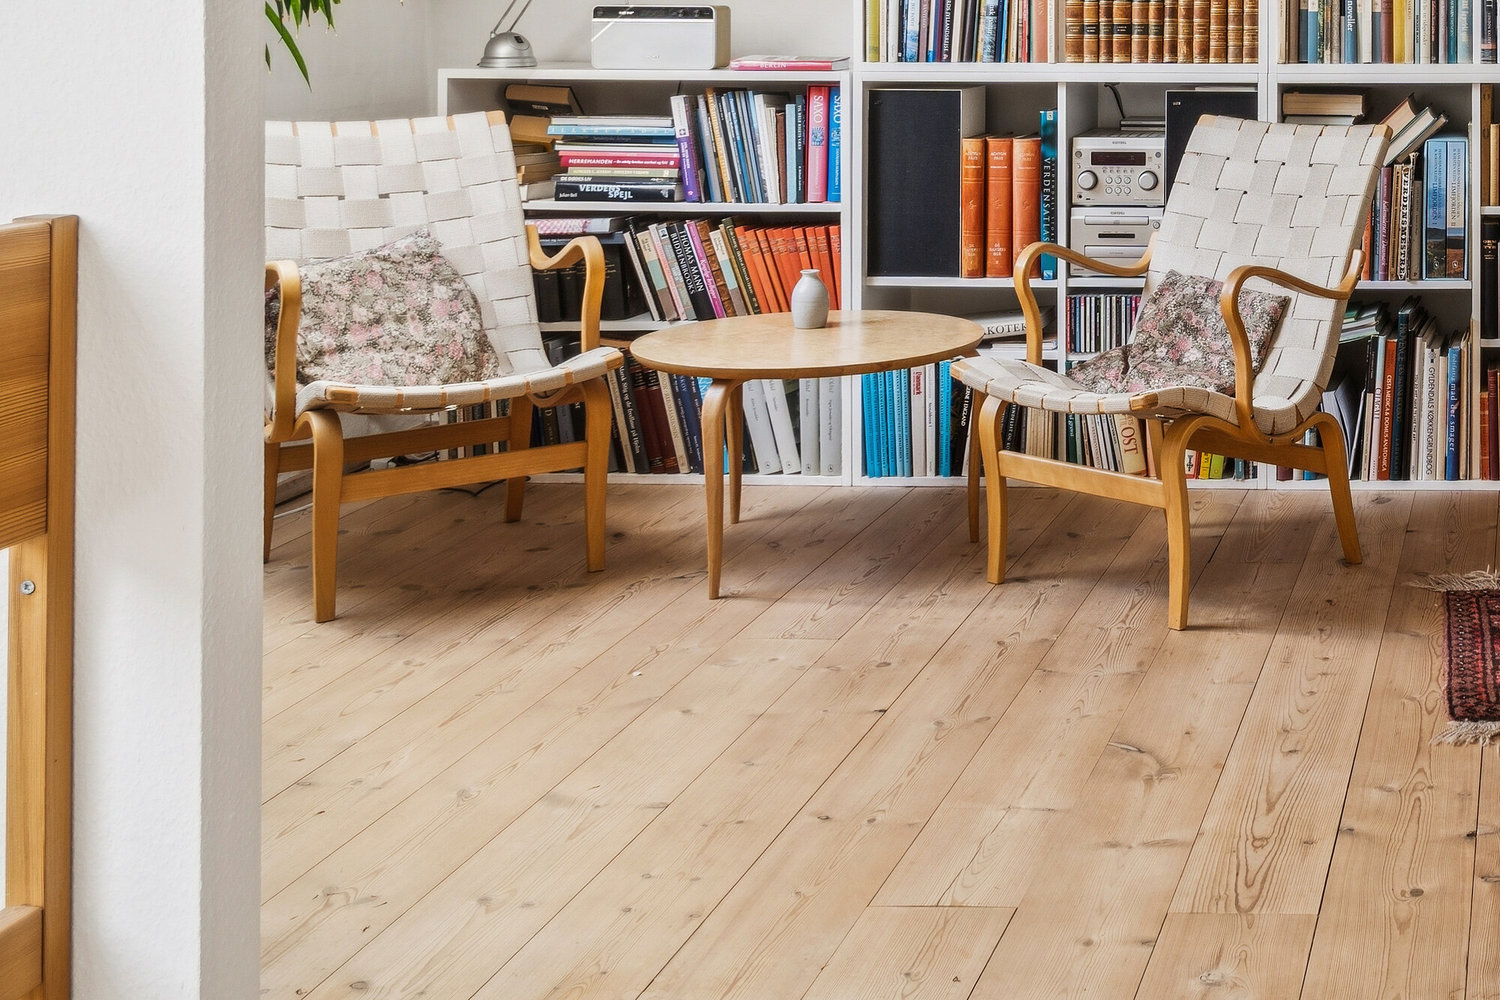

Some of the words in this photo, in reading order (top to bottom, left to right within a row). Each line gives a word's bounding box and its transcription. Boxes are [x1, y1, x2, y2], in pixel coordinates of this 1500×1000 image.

[1347, 0, 1355, 31] noveller
[813, 95, 823, 123] SAXO
[579, 184, 621, 192] VERDENS
[608, 191, 633, 199] SPEJL
[1043, 157, 1051, 241] VERDENSATLAS
[670, 232, 695, 295] BUDDENBROOKS
[679, 230, 695, 264] THOMAS
[690, 265, 704, 291] MANN
[985, 323, 1027, 335] KOTE
[1427, 367, 1435, 408] GYLDENDALS
[1121, 427, 1139, 454] OST
[1426, 410, 1435, 475] KØKKENGRUNDBOG
